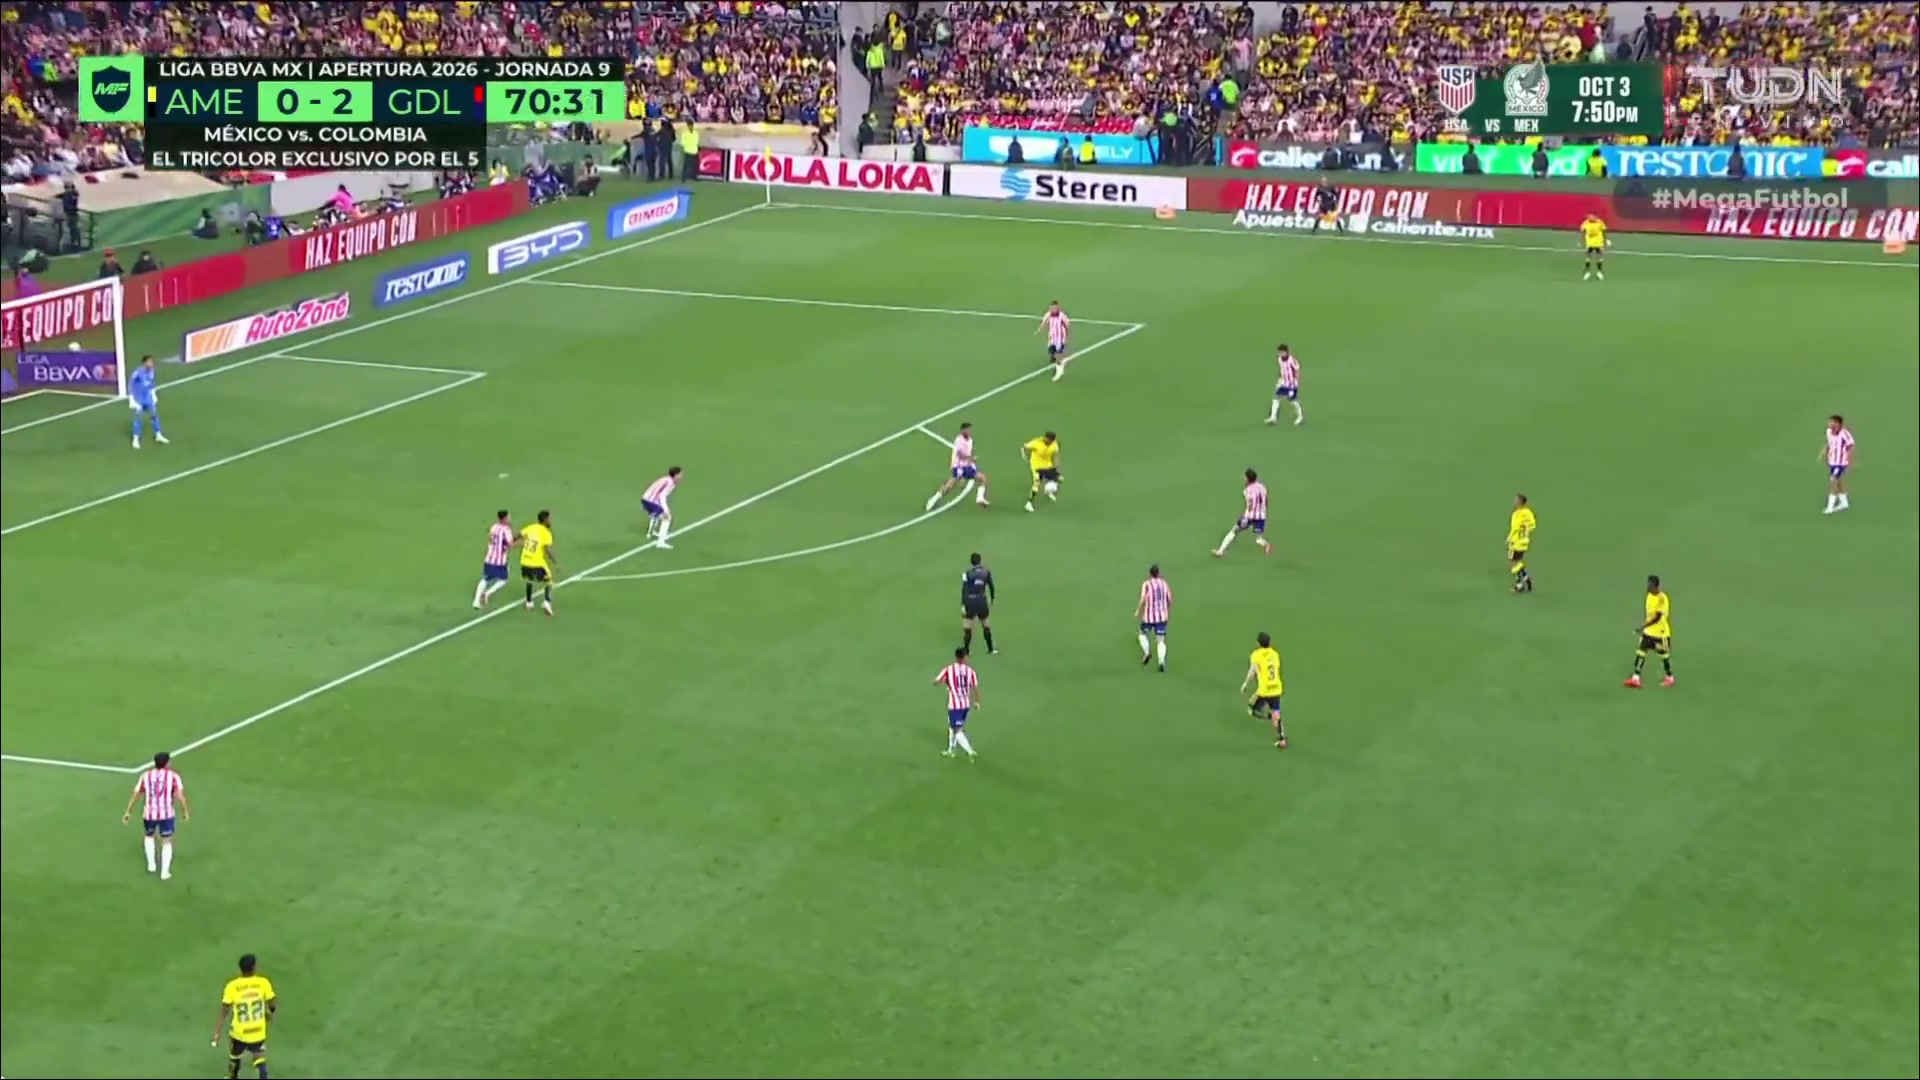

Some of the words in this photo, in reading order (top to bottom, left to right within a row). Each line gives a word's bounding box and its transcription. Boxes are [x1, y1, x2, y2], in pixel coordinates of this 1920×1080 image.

[734, 153, 831, 186] KOLA
[838, 158, 935, 193] LOKA
[1035, 174, 1138, 202] Steren
[1244, 183, 1288, 212] HAZ
[1294, 186, 1376, 217] EQIPO
[1382, 190, 1429, 219] CON
[305, 234, 333, 271] HAZ
[337, 218, 386, 261] EQUIPO
[390, 211, 418, 247] CON
[1705, 207, 1756, 234] HAZ
[1762, 208, 1859, 239] EQUIPO
[503, 227, 584, 269] BYD
[22, 295, 85, 343] EQUIPO
[90, 284, 124, 326] CO
[245, 297, 349, 344] AutoZone
[17, 354, 49, 365] LIGA
[33, 364, 91, 381] BBVA
